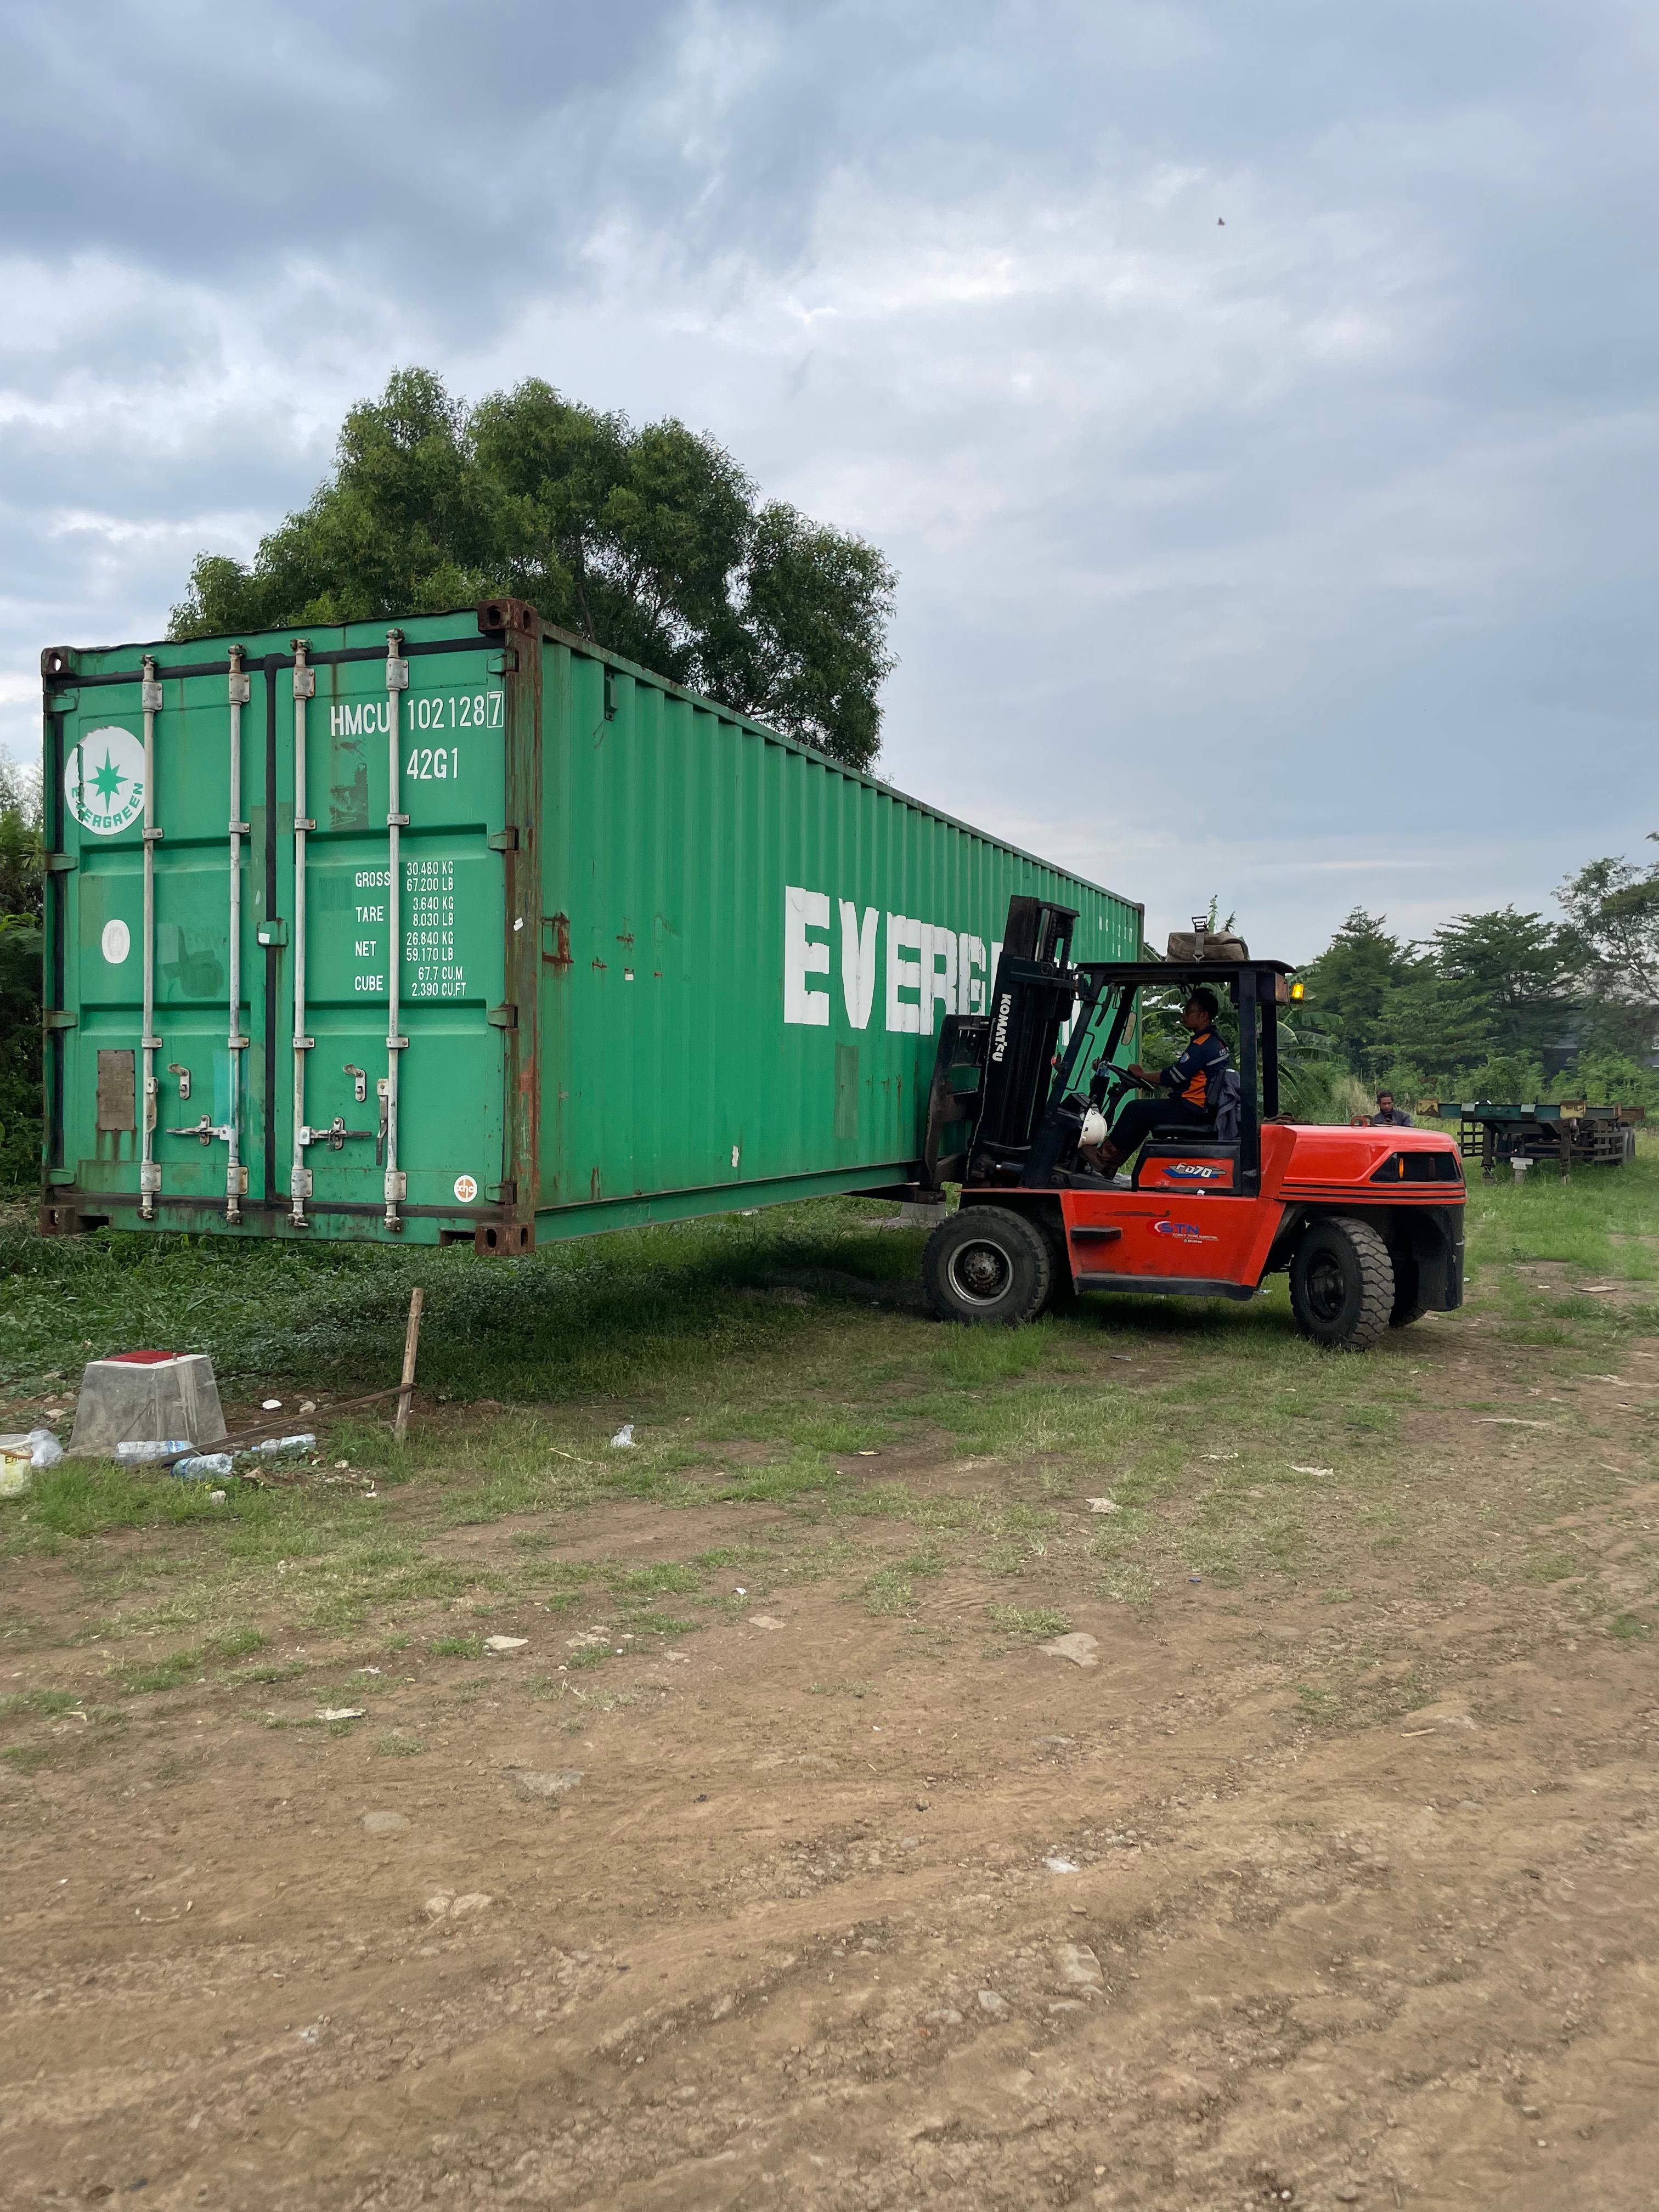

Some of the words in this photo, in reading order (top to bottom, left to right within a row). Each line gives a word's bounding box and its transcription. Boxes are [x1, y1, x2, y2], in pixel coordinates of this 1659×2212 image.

[330, 702, 390, 736] HMCU
[407, 747, 459, 780] 42G1
[407, 861, 439, 876] 30.480
[442, 861, 454, 874] KG
[356, 871, 391, 887] GROSS
[407, 878, 439, 891] 67.200
[442, 877, 454, 891] LB
[413, 896, 439, 911] 3.640
[442, 896, 454, 910] KG
[356, 906, 384, 922] TARE
[413, 912, 439, 927] 8.030
[442, 912, 454, 926] LB
[407, 932, 439, 946] 26.840
[442, 931, 454, 945] KG
[355, 940, 377, 957] NET
[406, 947, 439, 961] 59.170
[442, 947, 454, 961] LB
[418, 966, 438, 980] 67.7
[442, 966, 463, 980] CU.M
[784, 885, 1081, 1046] EVERG
[355, 975, 384, 991] CUBE
[411, 983, 438, 997] 2.390
[442, 982, 467, 996] CU.FT
[992, 993, 1012, 1062] KOMATSU
